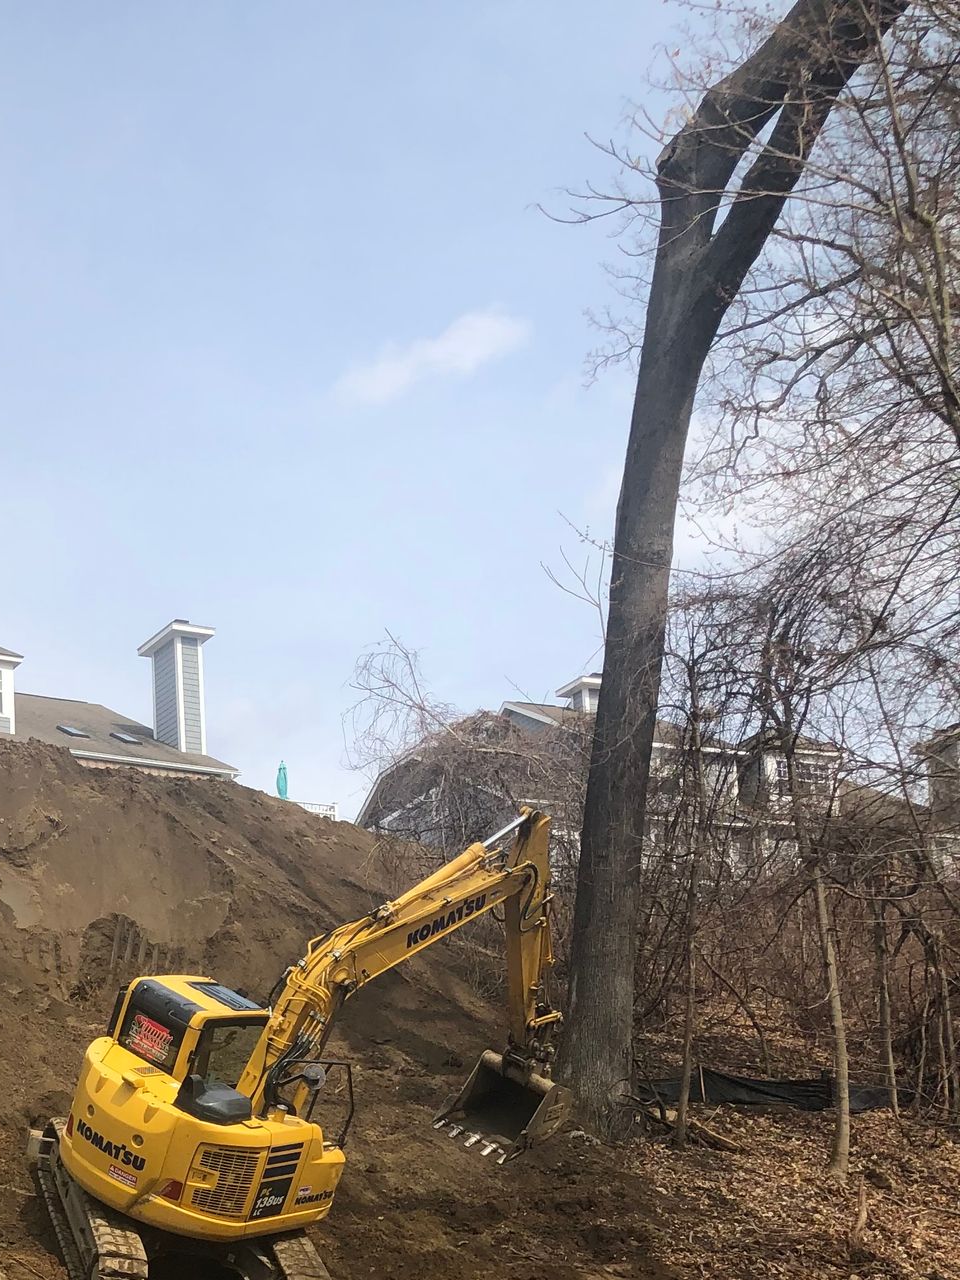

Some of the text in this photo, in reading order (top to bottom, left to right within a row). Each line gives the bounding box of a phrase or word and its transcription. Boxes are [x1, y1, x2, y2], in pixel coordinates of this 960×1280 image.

[406, 894, 486, 948] KOMATSU
[77, 1118, 146, 1171] KOMATSU
[114, 1168, 138, 1182] DANGER
[260, 1187, 272, 1197] PC
[294, 1190, 334, 1206] KOMATSU
